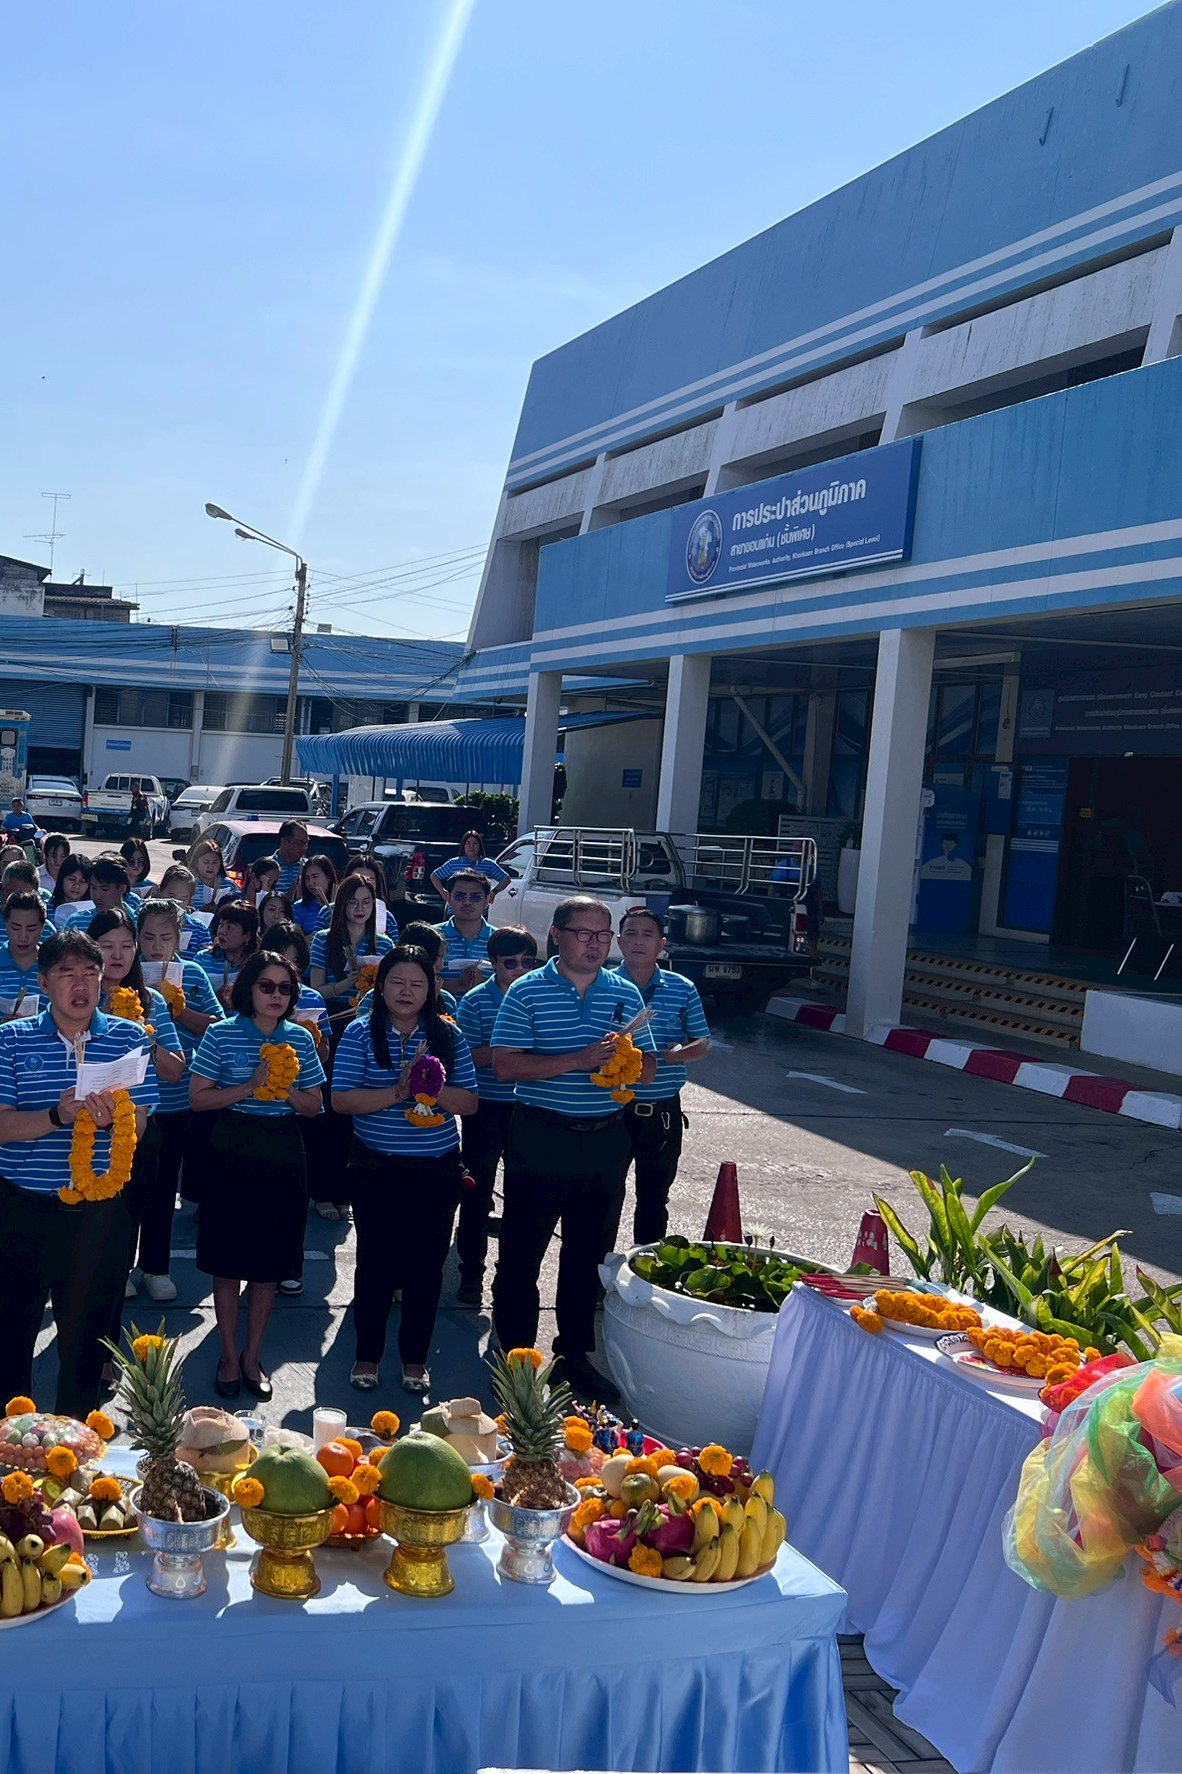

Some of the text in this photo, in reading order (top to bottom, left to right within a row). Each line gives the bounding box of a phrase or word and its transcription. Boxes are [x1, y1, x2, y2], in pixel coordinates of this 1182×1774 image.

[732, 479, 867, 532] การประปาส่วนภูมิภาค
[730, 524, 815, 557] สาขาขอนแก่น (ชั้นพิเศษ)
[728, 563, 748, 573] Provincial
[747, 558, 771, 569] Waterworks
[792, 549, 814, 560] Khonkaen
[814, 545, 830, 555] Branch
[830, 543, 845, 552] Office
